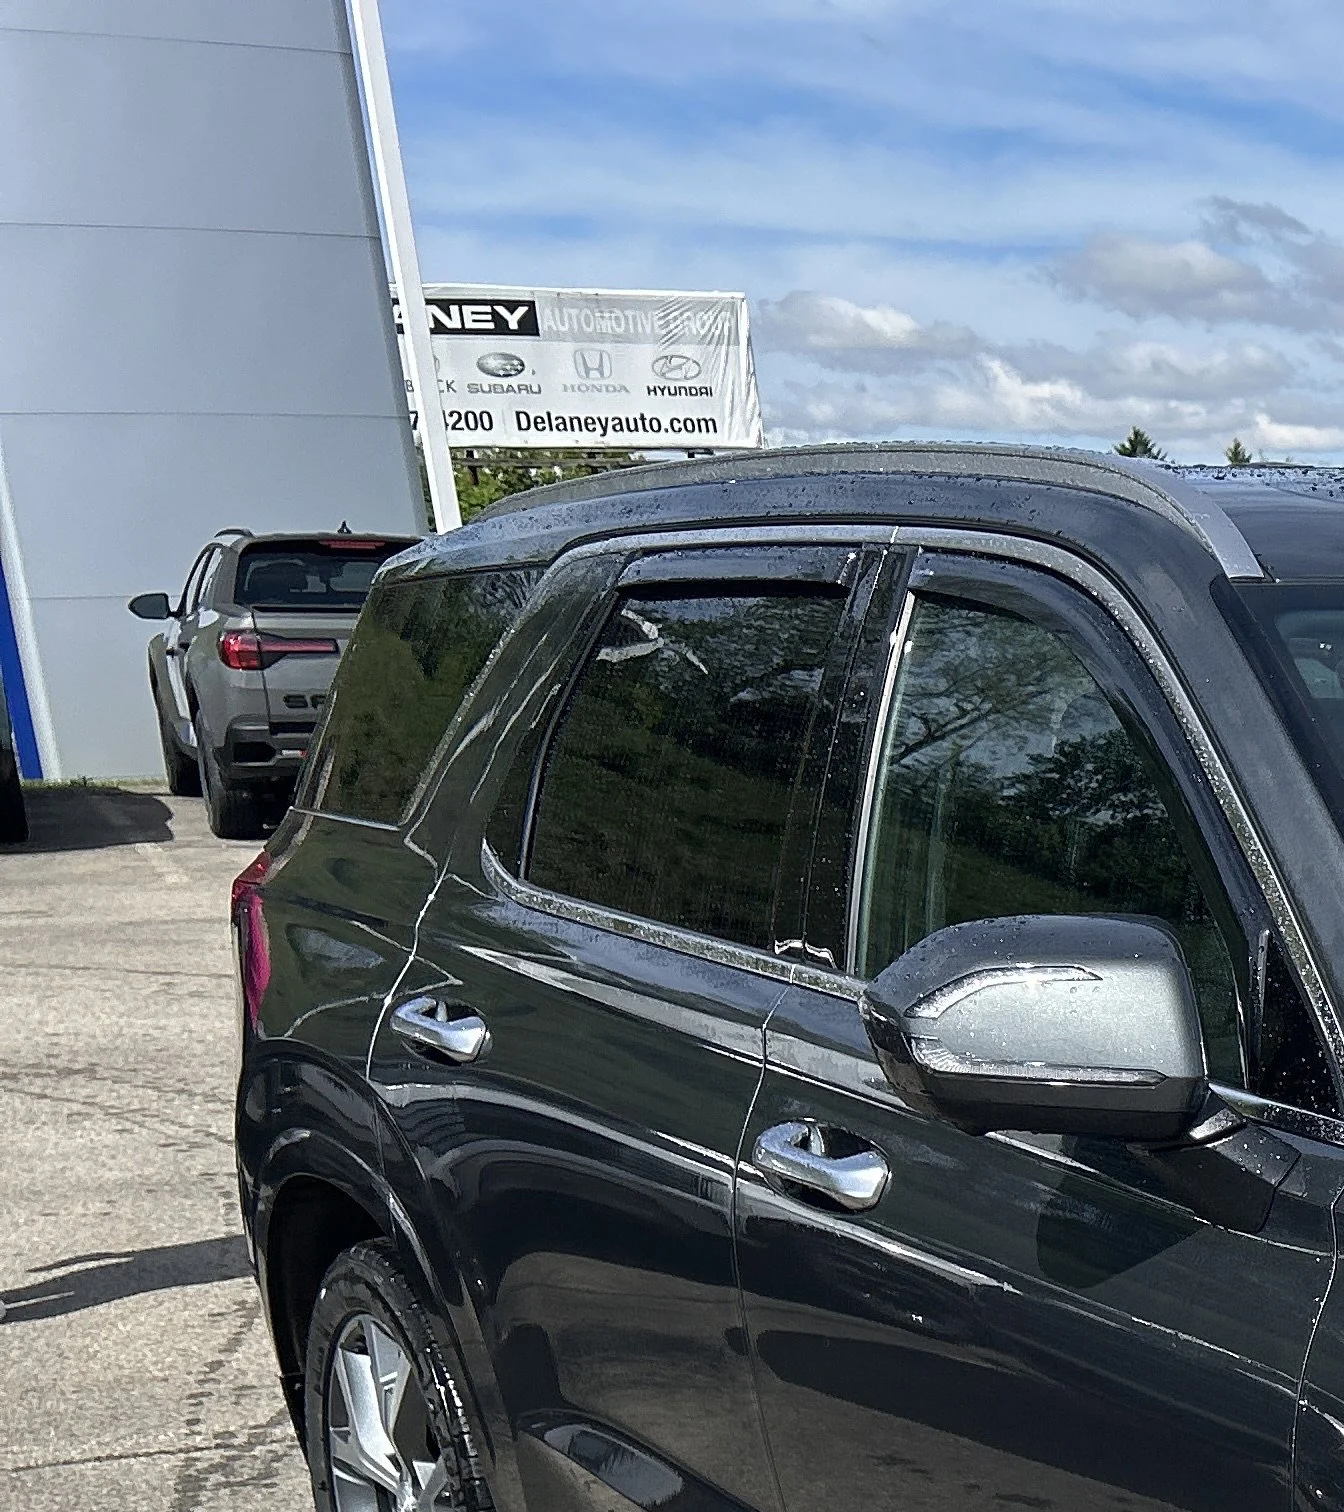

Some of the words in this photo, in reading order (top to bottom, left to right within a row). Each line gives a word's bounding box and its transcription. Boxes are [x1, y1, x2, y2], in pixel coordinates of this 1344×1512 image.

[467, 383, 542, 395] SUBARU
[562, 383, 630, 393] HONDA
[647, 385, 714, 397] HYUNDAI
[516, 411, 718, 437] Delaneyauto.com
